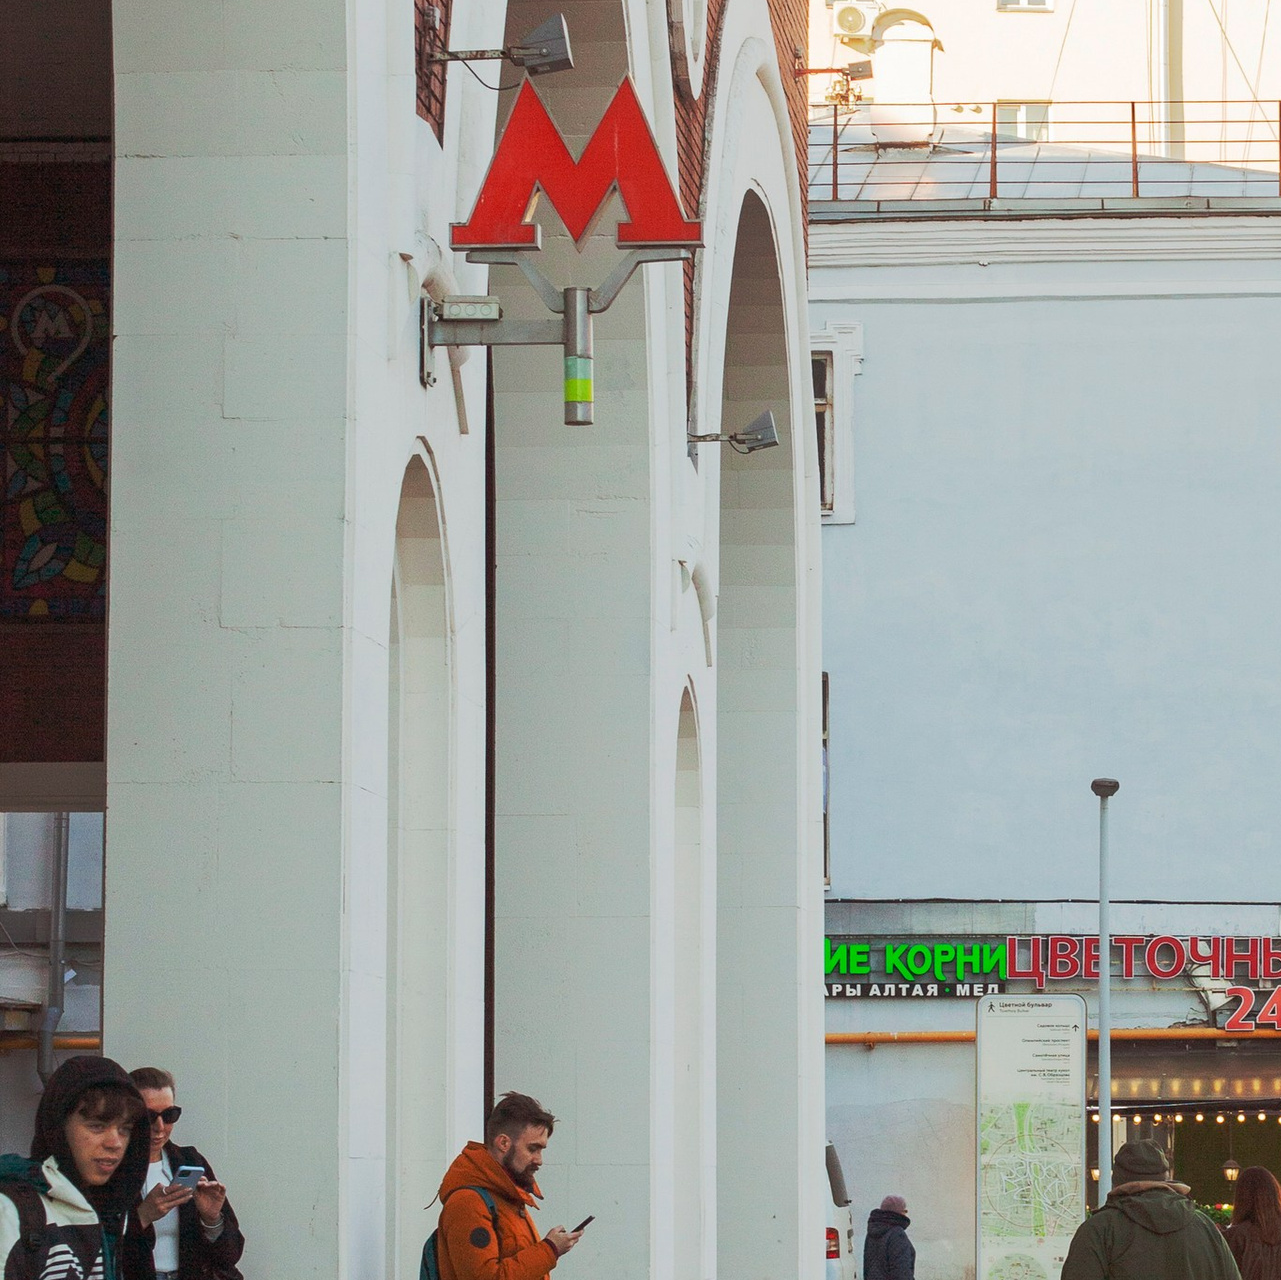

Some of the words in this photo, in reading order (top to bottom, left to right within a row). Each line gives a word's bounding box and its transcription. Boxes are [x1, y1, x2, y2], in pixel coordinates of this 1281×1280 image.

[449, 72, 705, 253] М
[885, 943, 1006, 981] КОРНИ
[869, 983, 938, 996] АЛТАЯ
